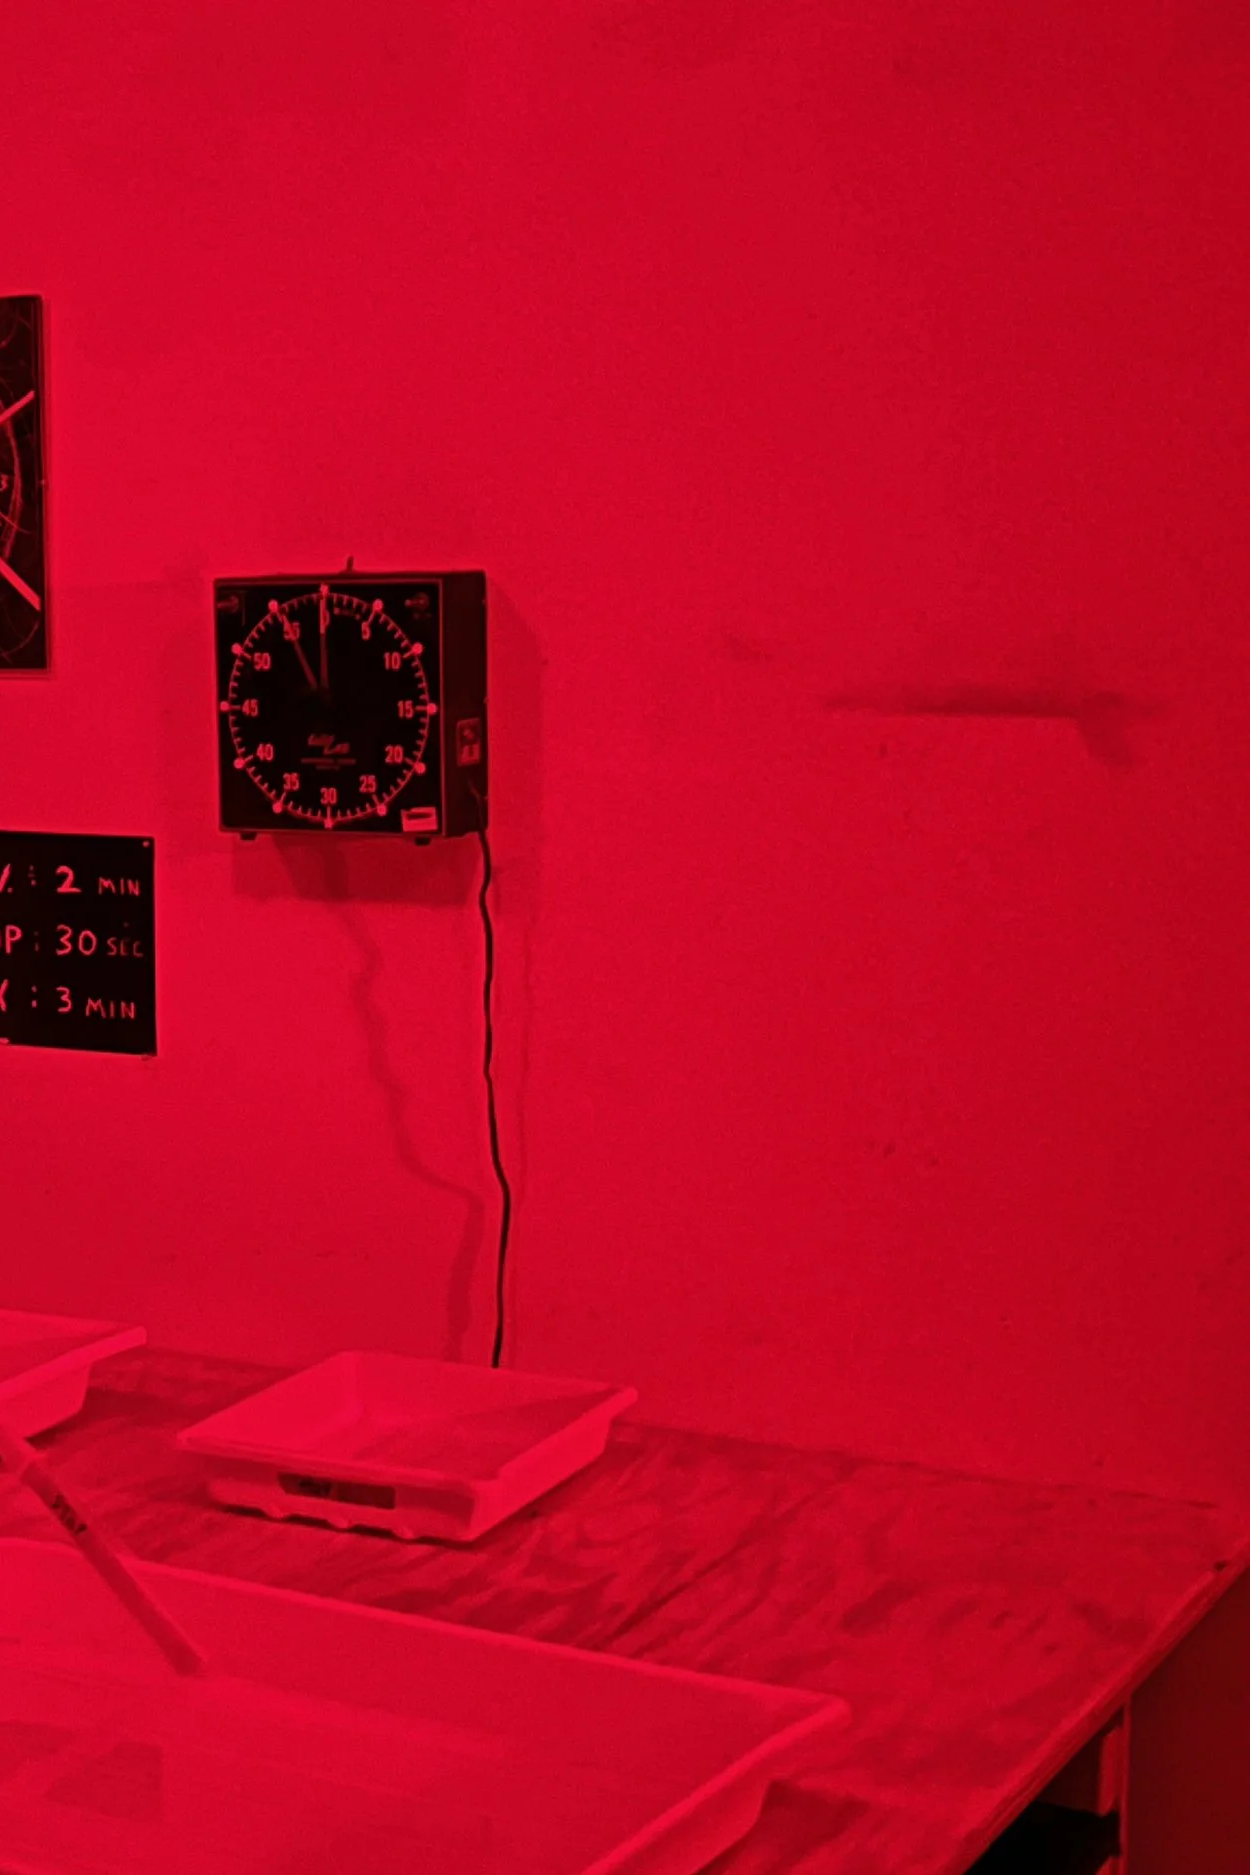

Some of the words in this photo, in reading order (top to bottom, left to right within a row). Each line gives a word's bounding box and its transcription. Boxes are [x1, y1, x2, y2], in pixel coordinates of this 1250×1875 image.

[361, 621, 371, 640] 5
[253, 652, 271, 671] 50
[383, 652, 401, 670] 10
[242, 699, 259, 717] 45
[397, 700, 414, 719] 15
[256, 743, 274, 761] 40
[385, 745, 403, 764] 20
[283, 773, 299, 790] 35
[359, 775, 376, 793] 25
[320, 787, 337, 805] 30
[56, 865, 82, 893] 2
[98, 876, 140, 896] MIN
[55, 924, 97, 955] 30
[107, 936, 144, 957] SEC
[55, 986, 73, 1013] 3
[85, 997, 136, 1019] MIN
